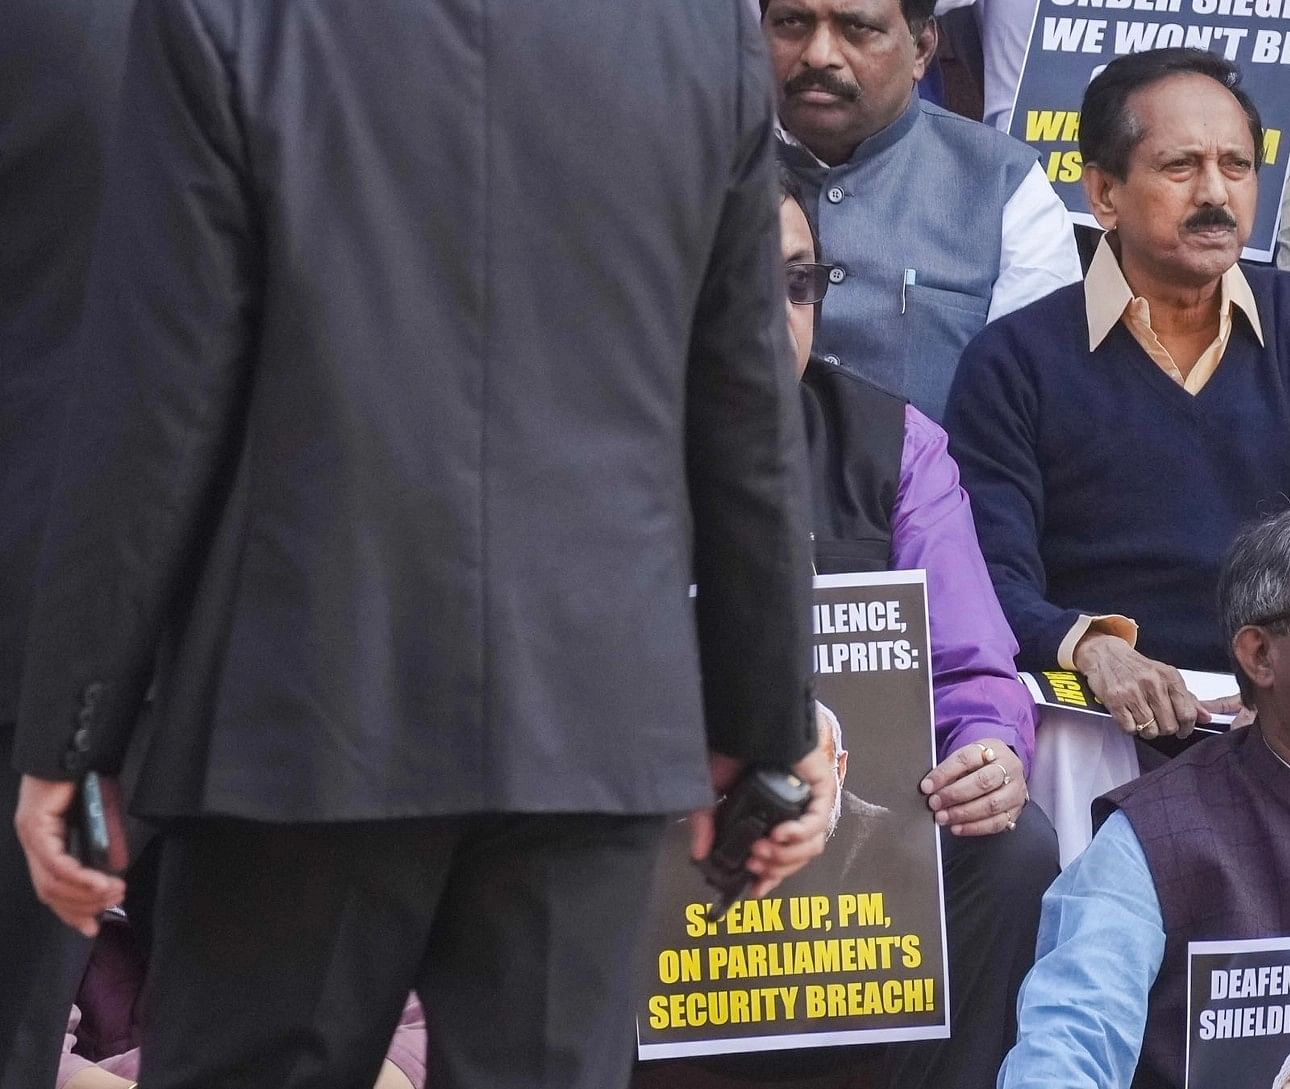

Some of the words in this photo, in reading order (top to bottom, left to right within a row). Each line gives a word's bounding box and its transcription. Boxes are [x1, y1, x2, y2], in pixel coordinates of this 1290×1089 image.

[1042, 17, 1105, 54] WE
[1047, 151, 1083, 183] IS
[813, 600, 907, 634] ILENCE,
[813, 639, 919, 674] LPRITS:
[789, 895, 832, 932] UP,
[838, 891, 891, 929] PM,
[658, 948, 701, 985] ON
[709, 933, 922, 981] PARLIAMENT'S
[648, 985, 801, 1031] SECURITY
[806, 977, 935, 1019] BREACH!
